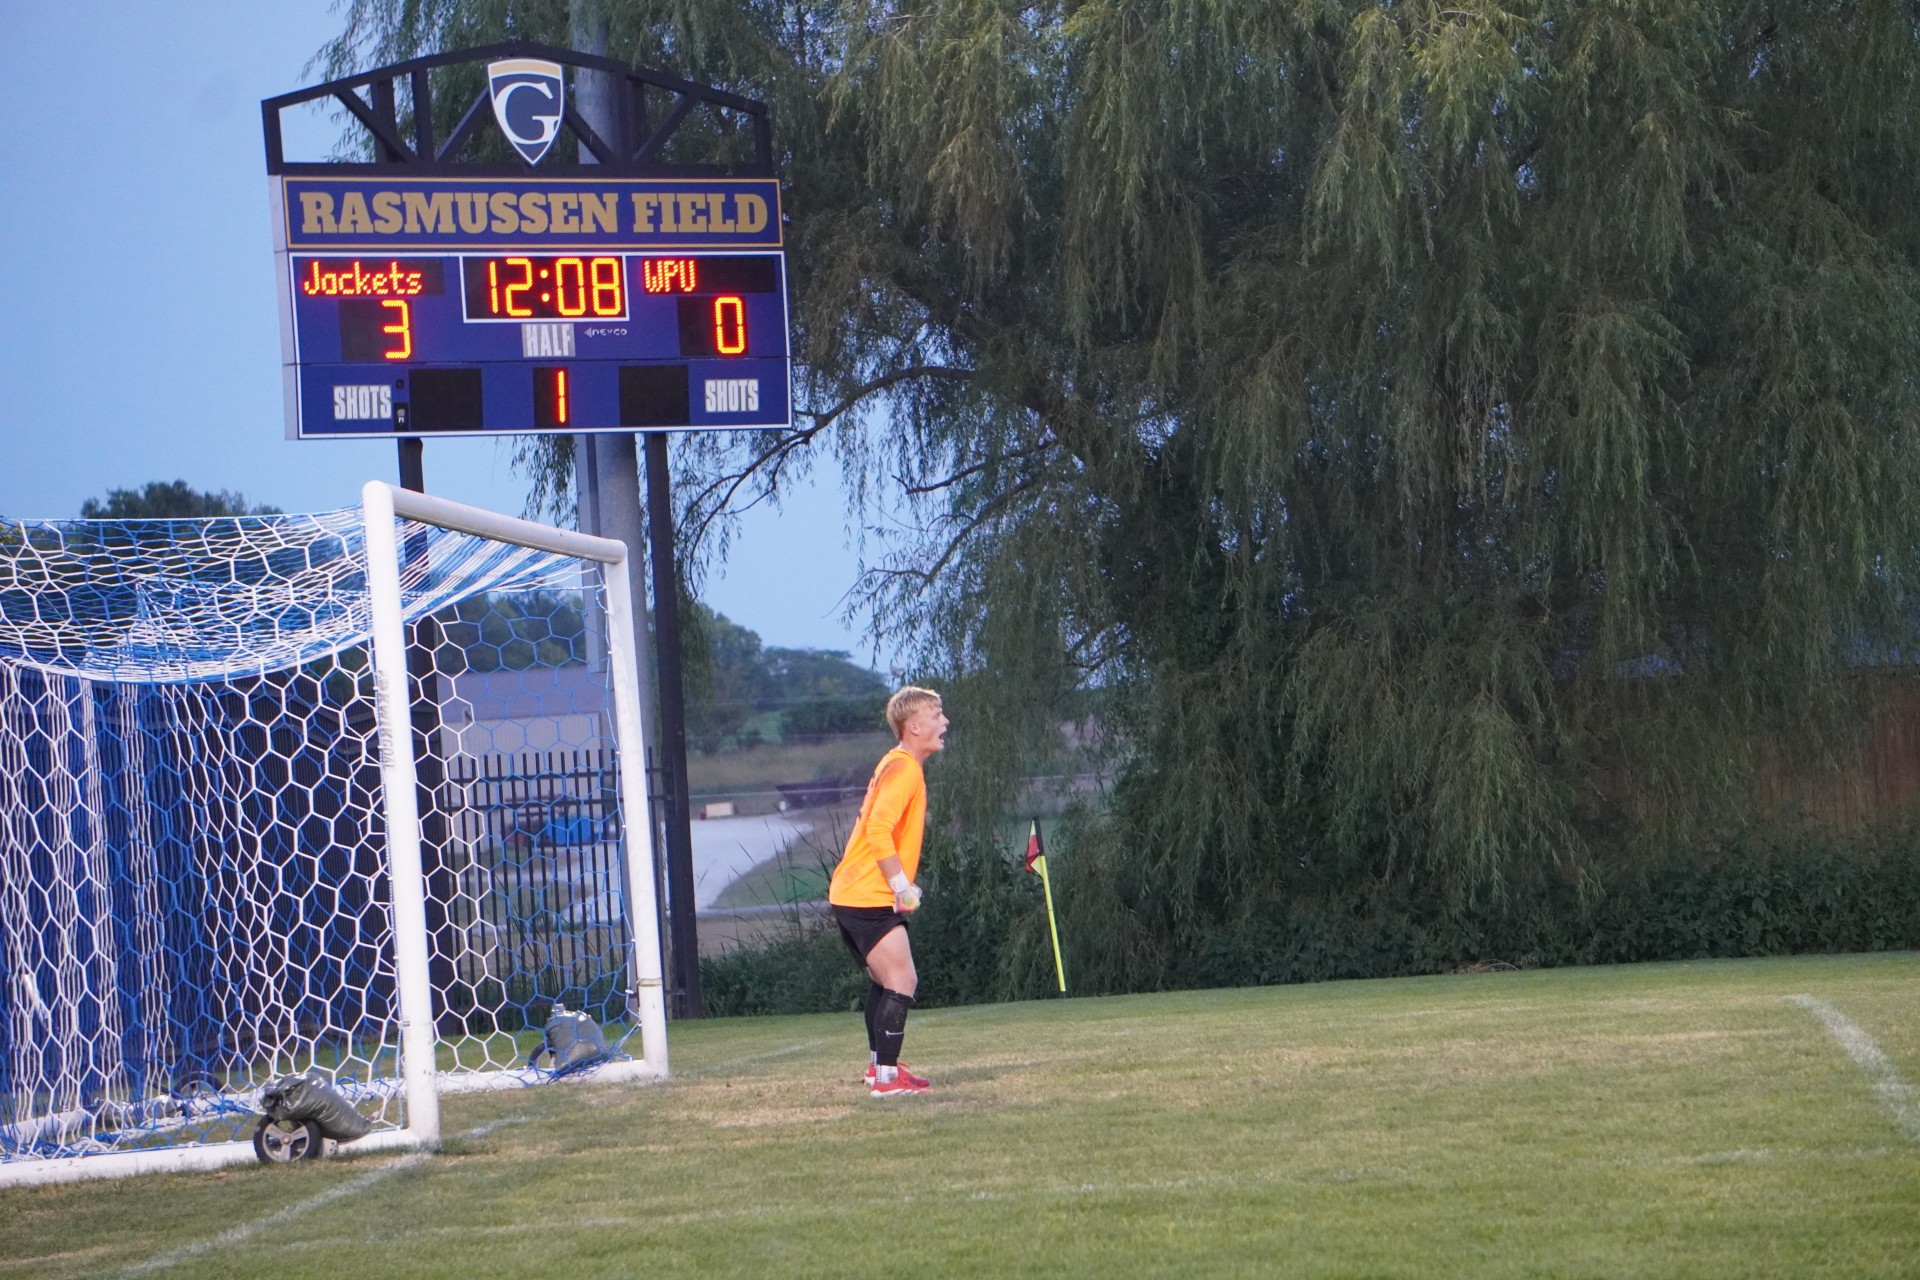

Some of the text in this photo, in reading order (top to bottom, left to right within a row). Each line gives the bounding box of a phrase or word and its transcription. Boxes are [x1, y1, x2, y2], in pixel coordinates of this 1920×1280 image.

[494, 82, 560, 144] G
[299, 191, 768, 234] RASMUSSEN FIELD
[304, 261, 422, 295] Jackets
[489, 257, 621, 317] 12:08
[644, 260, 696, 292] WPU
[382, 300, 411, 359] 3
[525, 324, 571, 357] HALF
[715, 296, 745, 354] 0
[334, 385, 392, 419] SHOTS
[558, 370, 566, 423] 1
[706, 380, 759, 413] SHOTS
